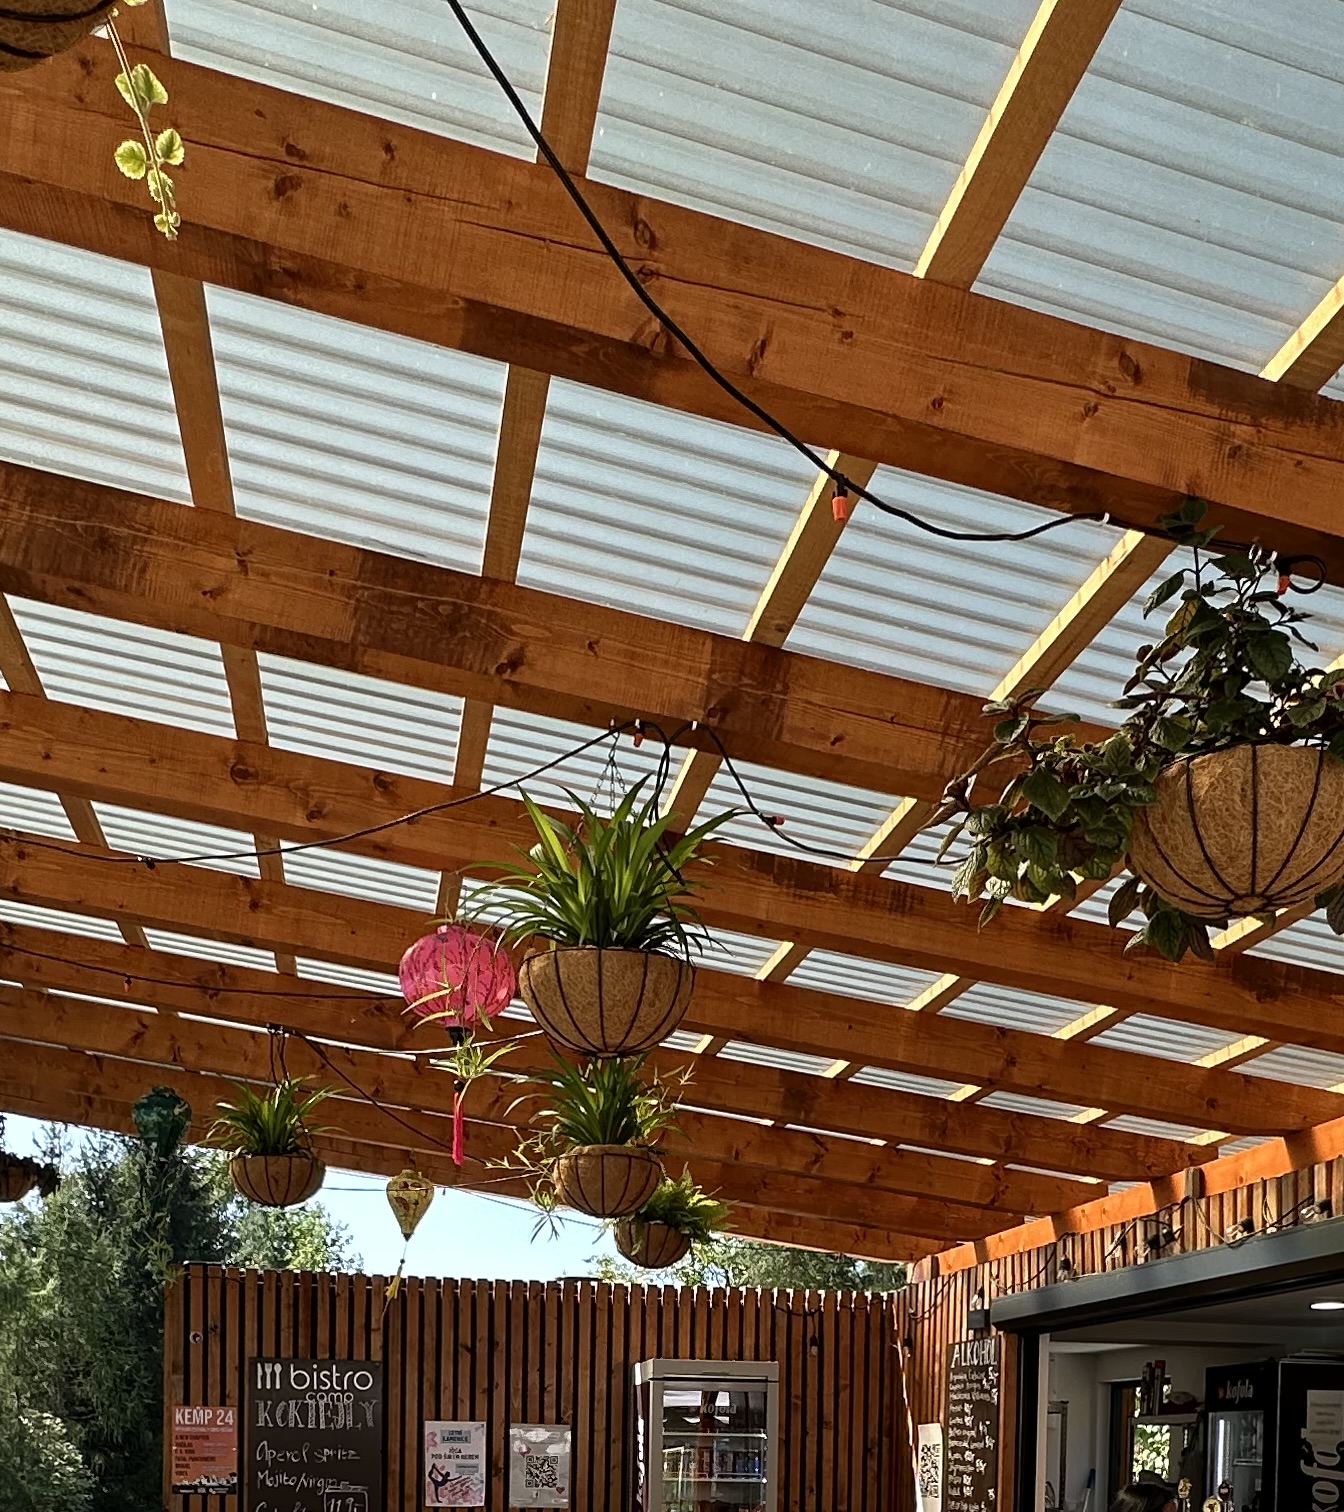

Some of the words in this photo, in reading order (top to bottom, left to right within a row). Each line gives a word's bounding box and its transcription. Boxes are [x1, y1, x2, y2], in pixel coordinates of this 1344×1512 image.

[950, 1338, 998, 1369] ALKOHOL
[290, 1363, 373, 1390] bistro
[1226, 1379, 1253, 1404] kofola
[175, 1408, 213, 1425] KEMP
[216, 1409, 234, 1426] 24
[256, 1441, 308, 1467] Aperol
